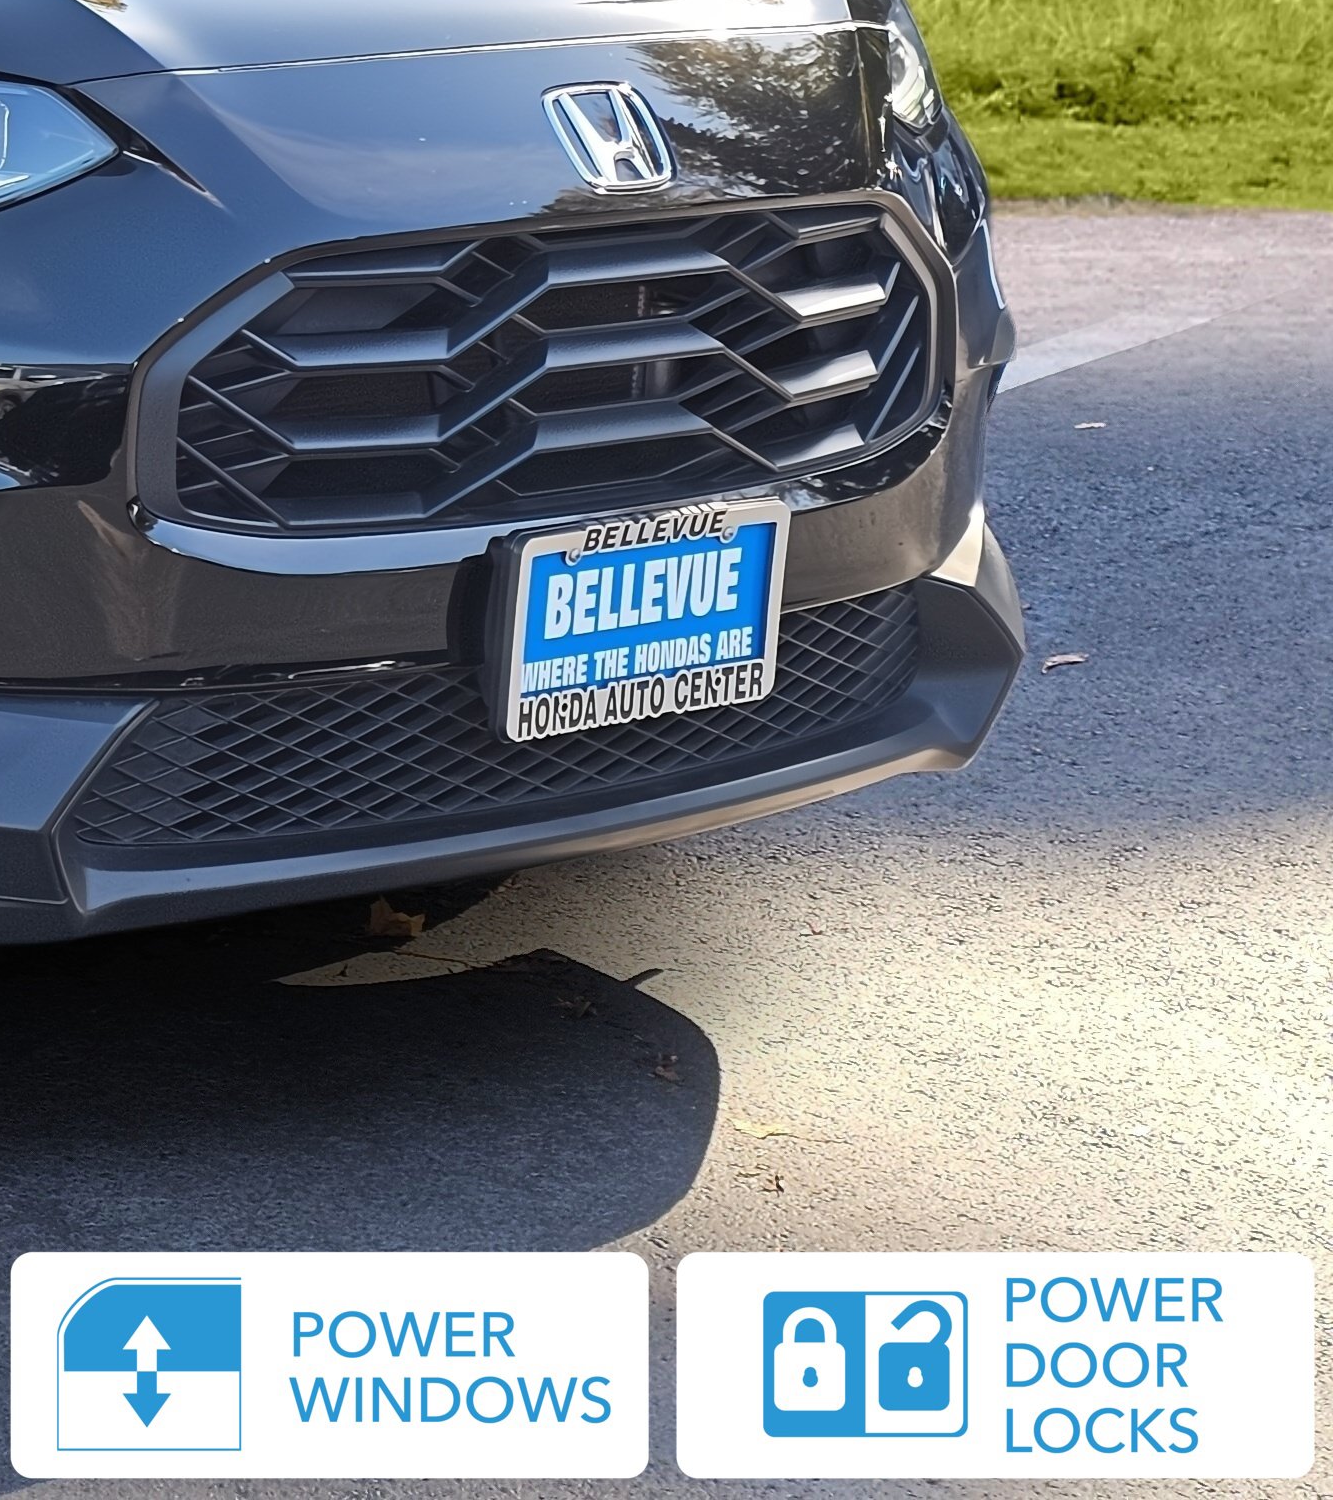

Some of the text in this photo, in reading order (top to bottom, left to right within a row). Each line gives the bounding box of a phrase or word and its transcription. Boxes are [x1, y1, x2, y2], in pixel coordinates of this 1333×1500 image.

[583, 510, 727, 552] BELLEVUE
[544, 547, 742, 640] BELLEVUE
[521, 626, 753, 694] WHERE THE HONDAS ARE
[518, 662, 764, 739] HONDA AUTO CENTER
